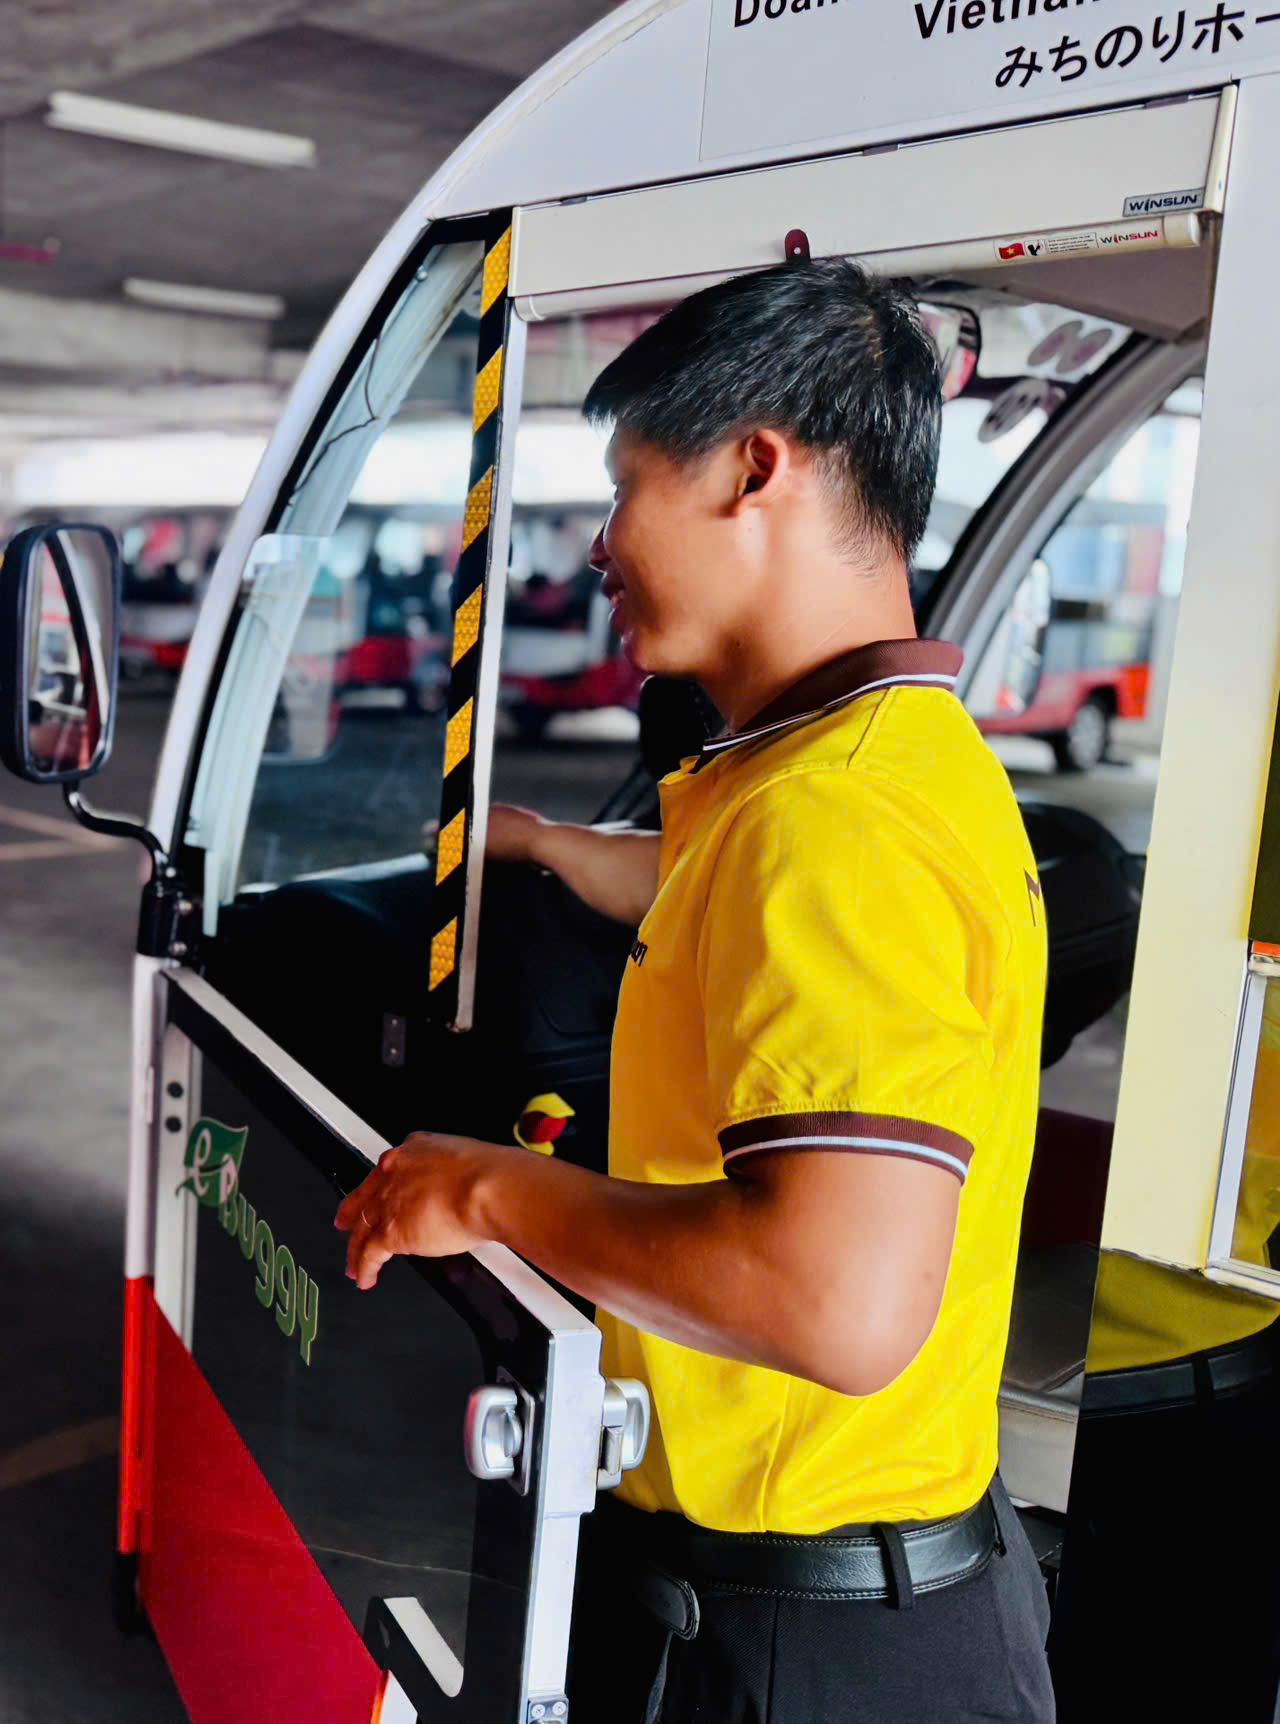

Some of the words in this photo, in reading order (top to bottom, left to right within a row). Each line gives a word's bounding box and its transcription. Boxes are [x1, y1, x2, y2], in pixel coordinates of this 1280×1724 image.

[734, 0, 839, 28] Doa
[914, 0, 1100, 39] Vietn
[1129, 194, 1198, 212] WINSUN
[1099, 230, 1159, 244] WINSUN
